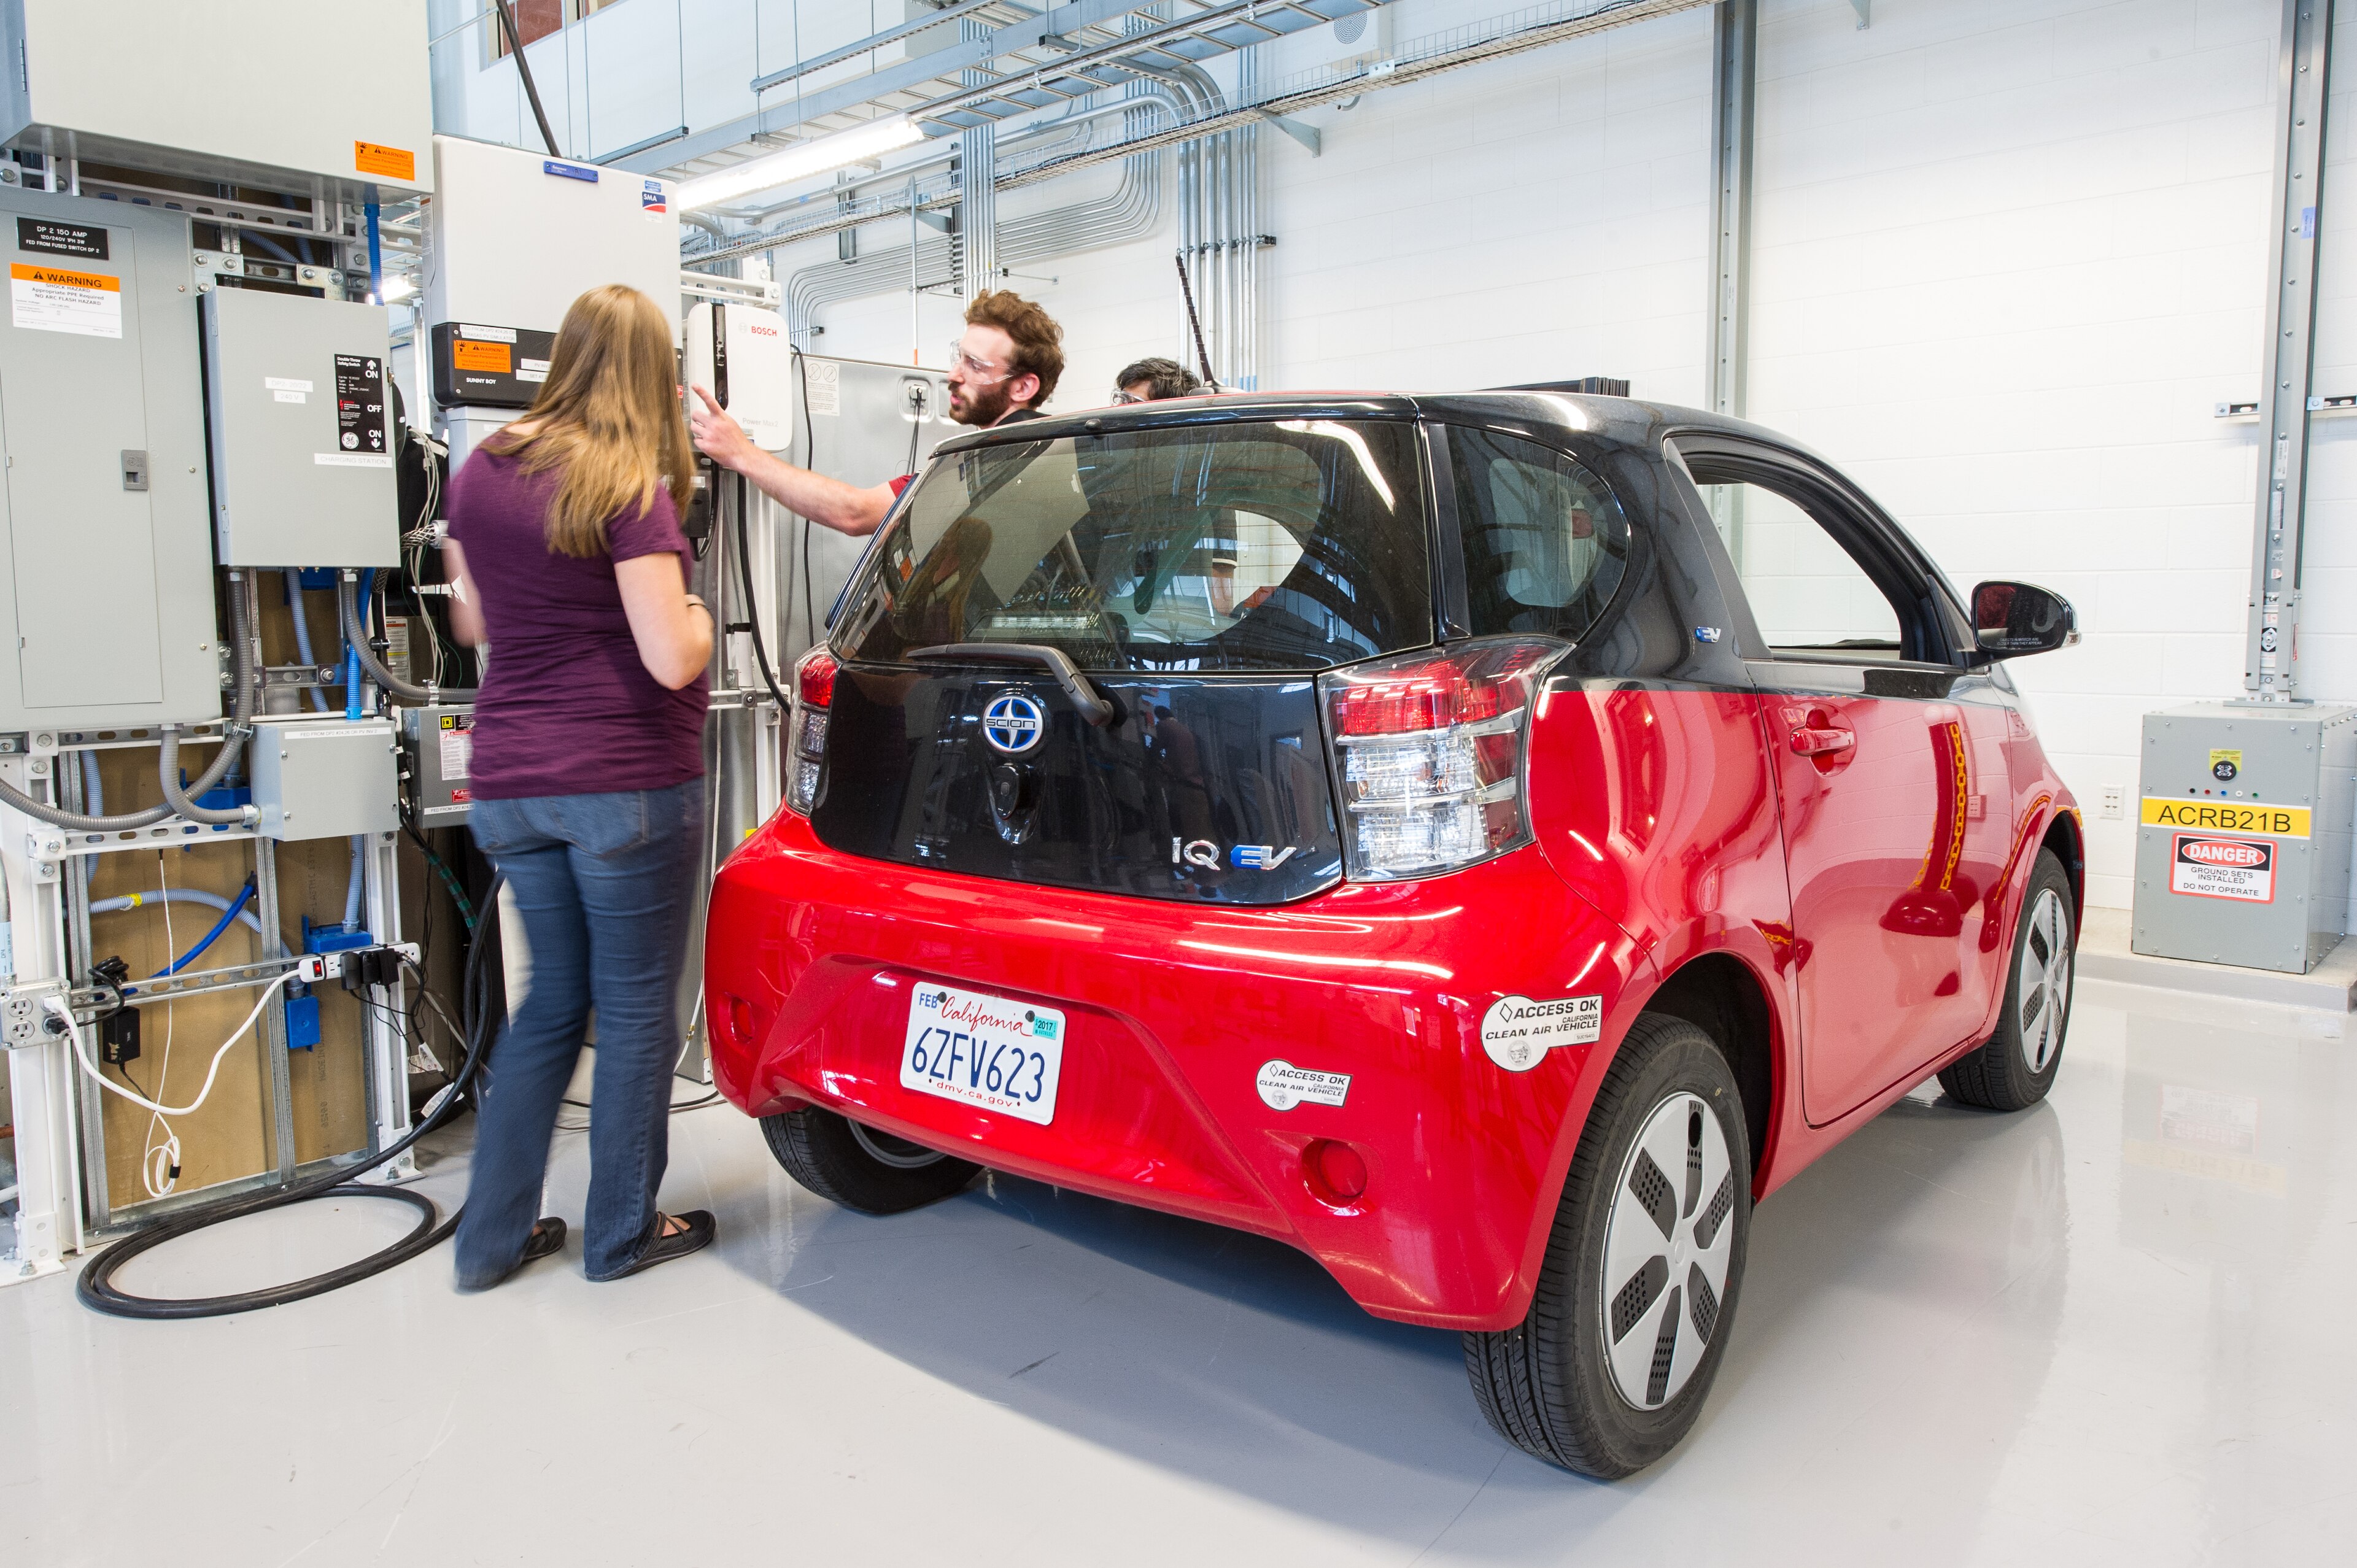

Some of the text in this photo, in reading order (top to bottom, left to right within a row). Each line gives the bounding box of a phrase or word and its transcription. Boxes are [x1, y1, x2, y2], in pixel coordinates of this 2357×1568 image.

[381, 150, 408, 159] WARNING
[47, 273, 102, 287] WARNING
[751, 326, 777, 336] BOSCH
[365, 369, 378, 379] ON
[367, 404, 382, 413] OFF
[1695, 626, 1721, 643] EV
[986, 719, 1035, 728] SCION
[2158, 805, 2291, 833] ACRB21B
[1230, 844, 1297, 871] EV
[2189, 844, 2258, 863] DANGER
[2191, 867, 2228, 876] GROUND
[2198, 874, 2245, 884] INSTALLED
[2218, 886, 2259, 896] OPERATE
[919, 992, 938, 1009] FEB
[941, 996, 1033, 1037] California
[1514, 999, 1598, 1019] ACCESS OK
[1038, 1020, 1053, 1031] 2017
[1562, 1013, 1598, 1023] CALIFORNIA
[1485, 1020, 1598, 1040] CLEAN AIR VEHICLE
[911, 1027, 1045, 1102] 6ZFV623
[1278, 1070, 1347, 1085] ACCESS OK
[937, 1081, 1013, 1106] dmv.ca.gov
[1259, 1079, 1287, 1088] CLEAN
[1308, 1087, 1343, 1097] VEHICLE
